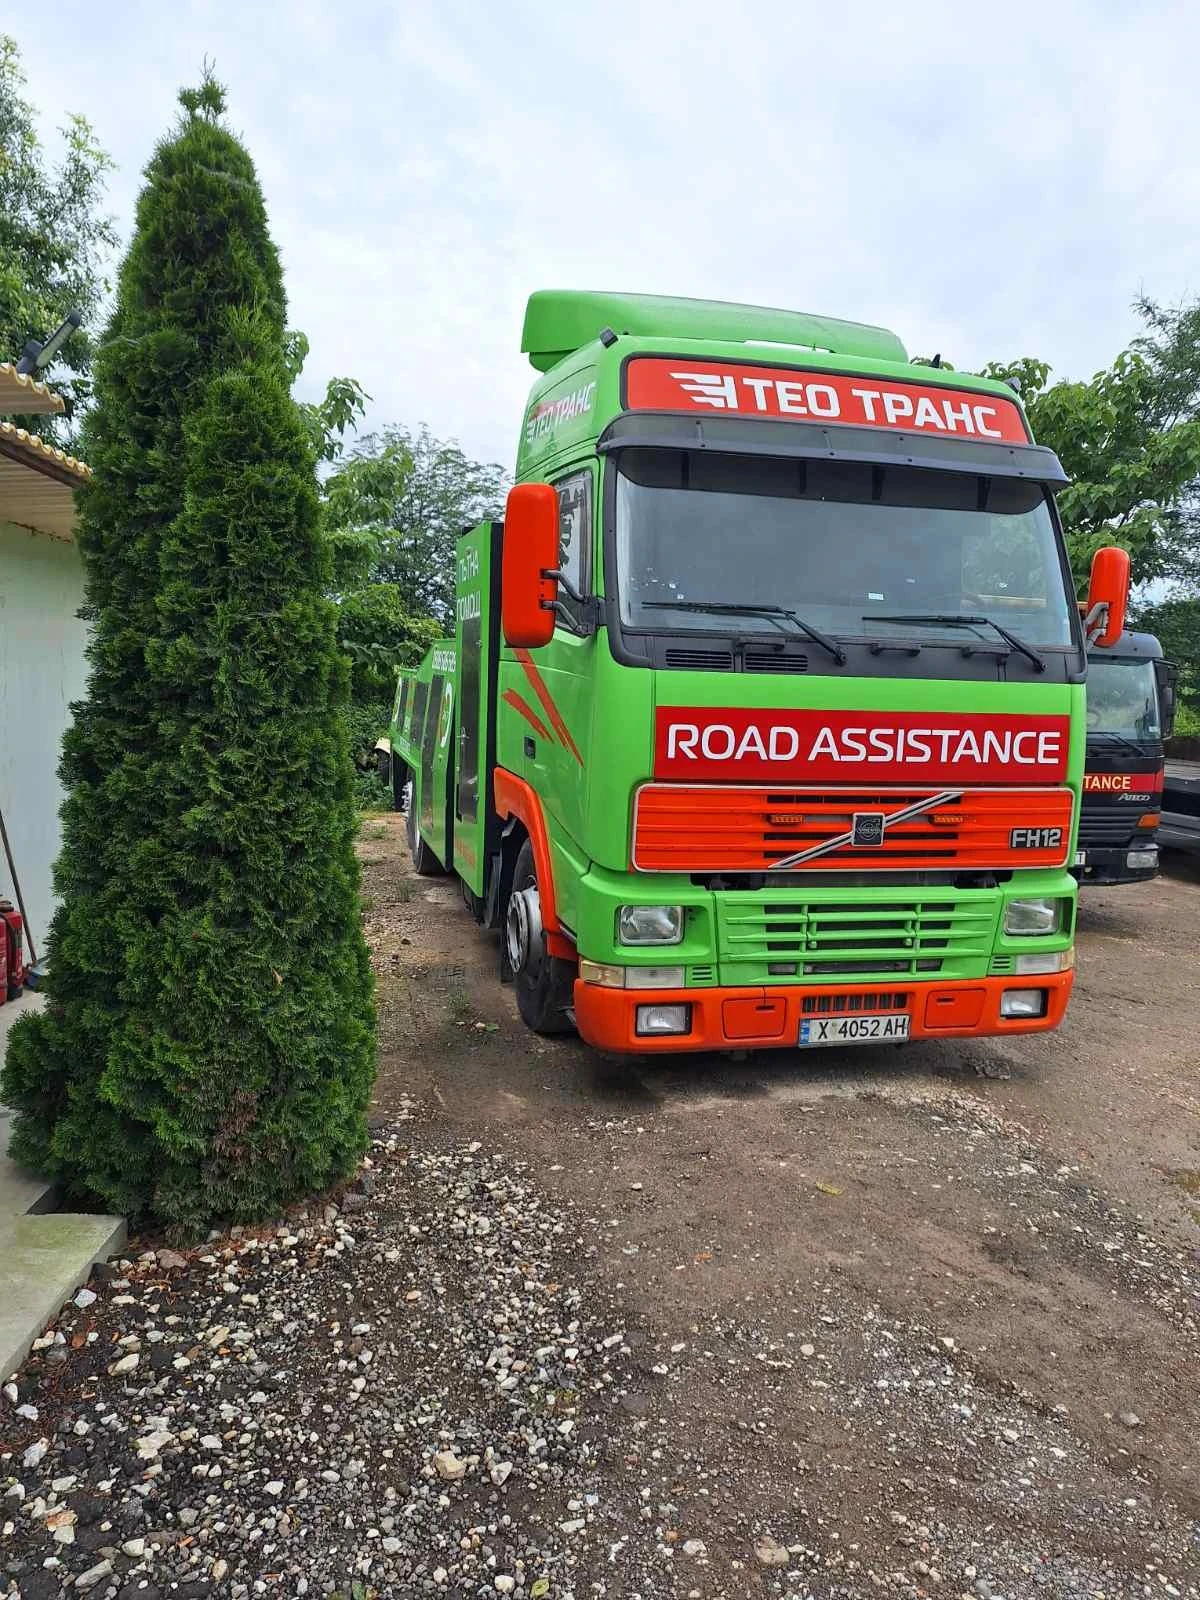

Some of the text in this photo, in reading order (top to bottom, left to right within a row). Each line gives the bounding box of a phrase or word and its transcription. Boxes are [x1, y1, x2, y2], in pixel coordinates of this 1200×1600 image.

[743, 377, 1002, 438] ТЕО ТРАНС
[667, 723, 1061, 764] ROAD ASSISTANCE
[1012, 829, 1061, 848] FH12
[838, 1019, 880, 1038] 4052
[883, 1017, 906, 1036] AH
